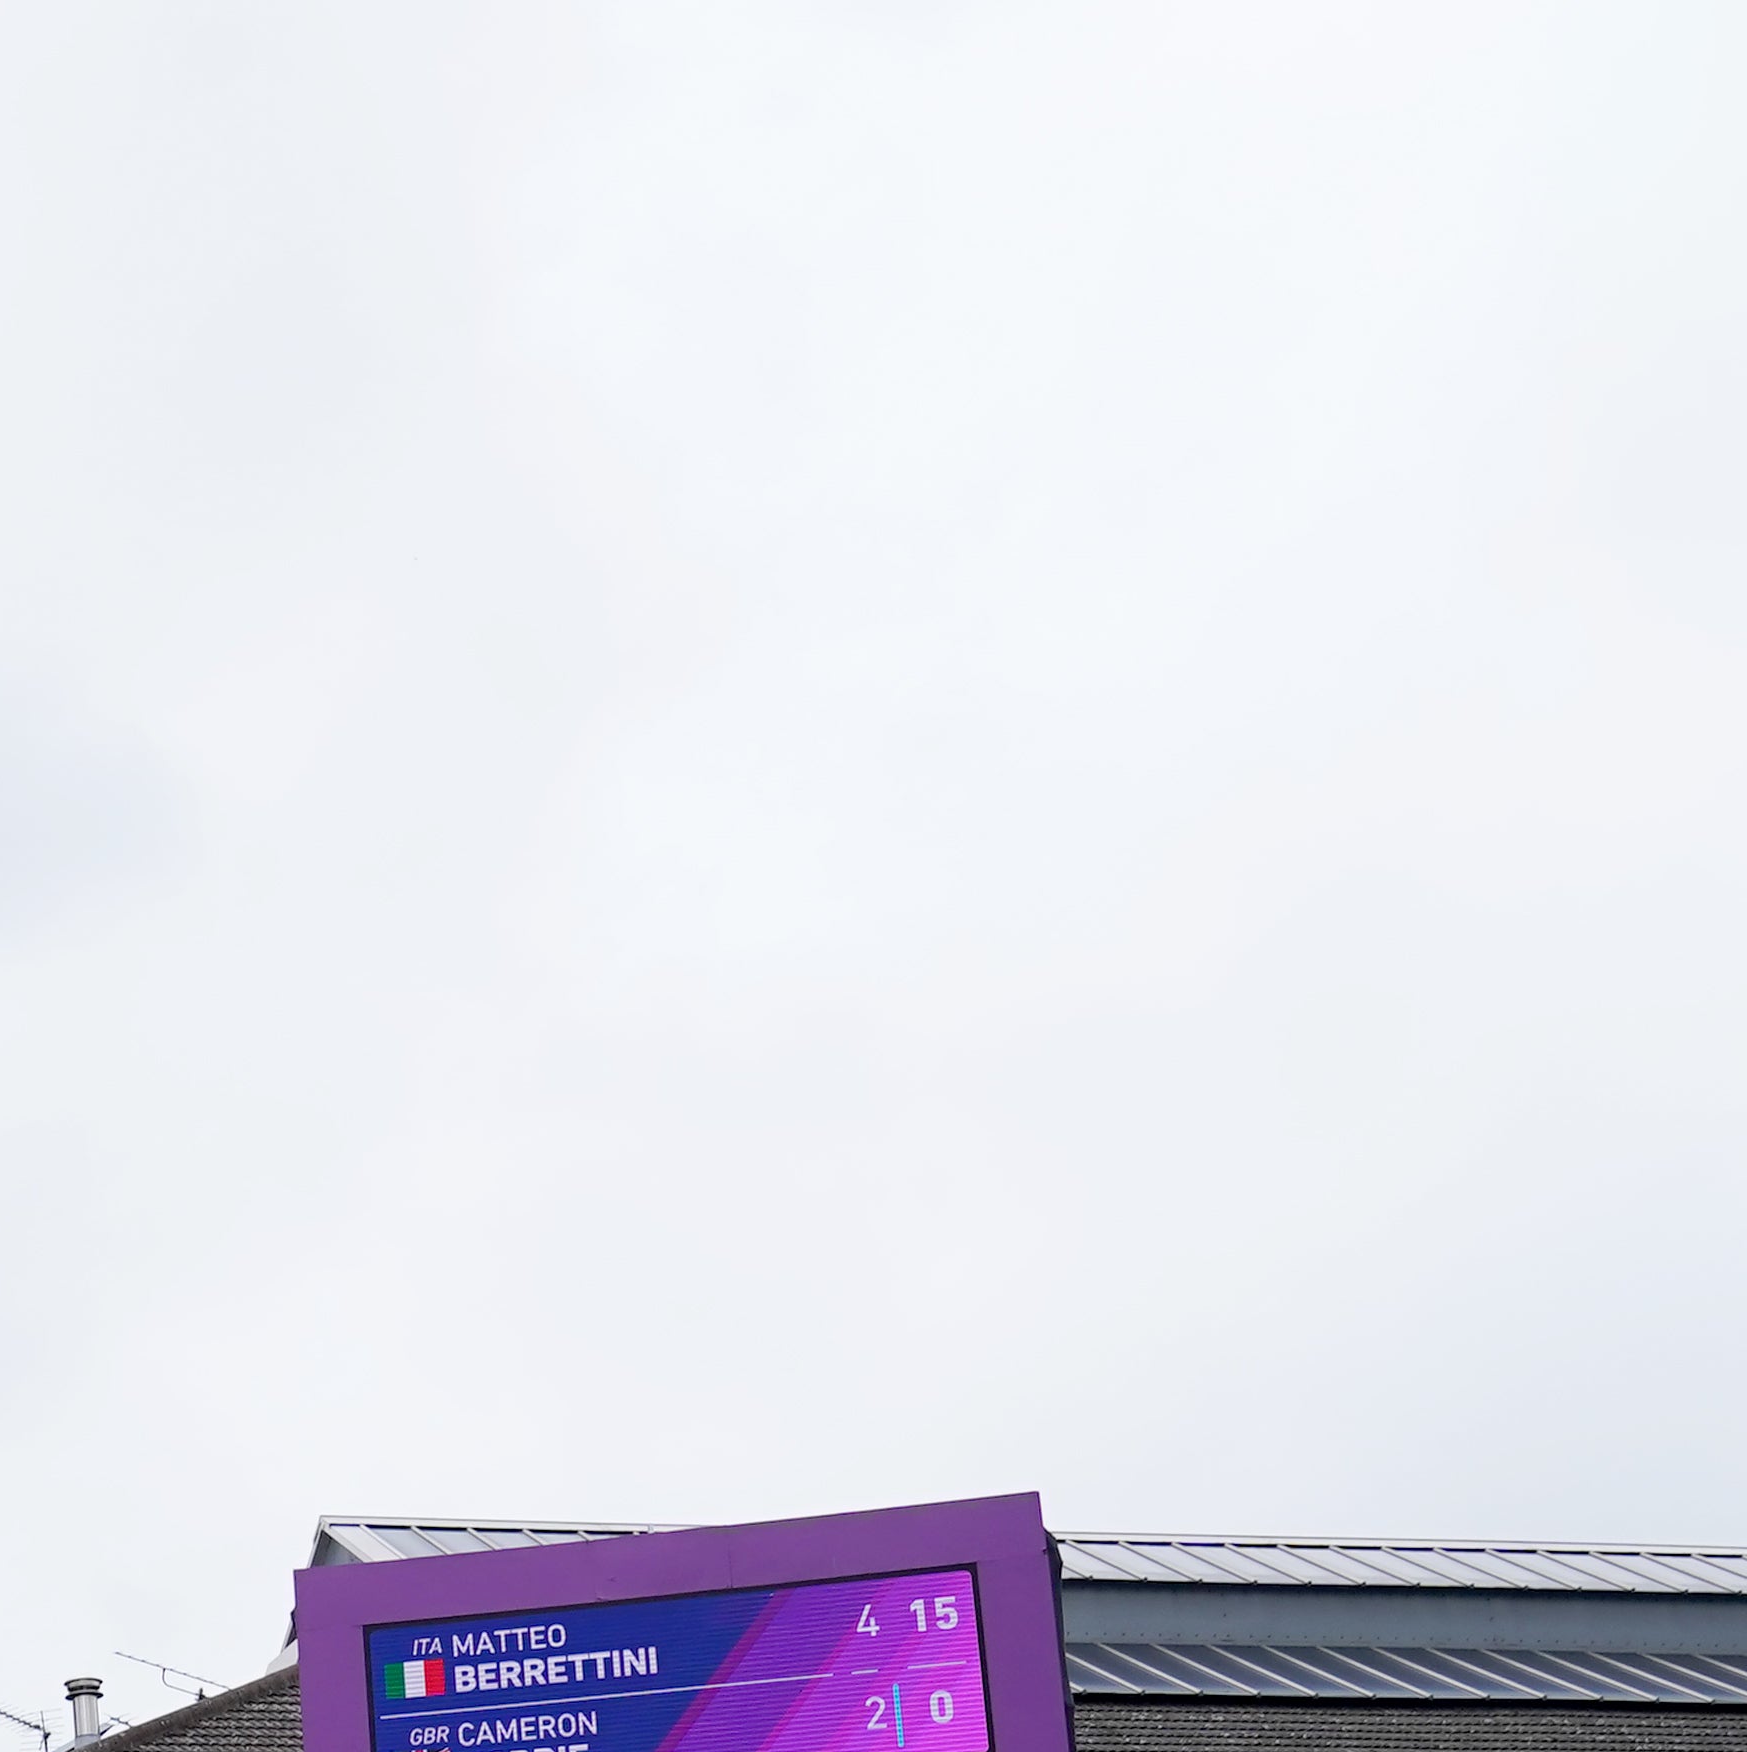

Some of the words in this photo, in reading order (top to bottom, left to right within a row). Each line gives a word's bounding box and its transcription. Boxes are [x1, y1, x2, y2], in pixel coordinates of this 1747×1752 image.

[452, 1624, 567, 1657] MATTEO
[856, 1604, 881, 1637] 4
[909, 1596, 958, 1632] 15
[412, 1637, 443, 1656] ITA
[454, 1646, 658, 1693] BERRETTINI
[458, 1711, 598, 1747] CAMERON
[865, 1696, 888, 1730] 2
[929, 1690, 954, 1724] 0
[409, 1726, 450, 1746] GBR
